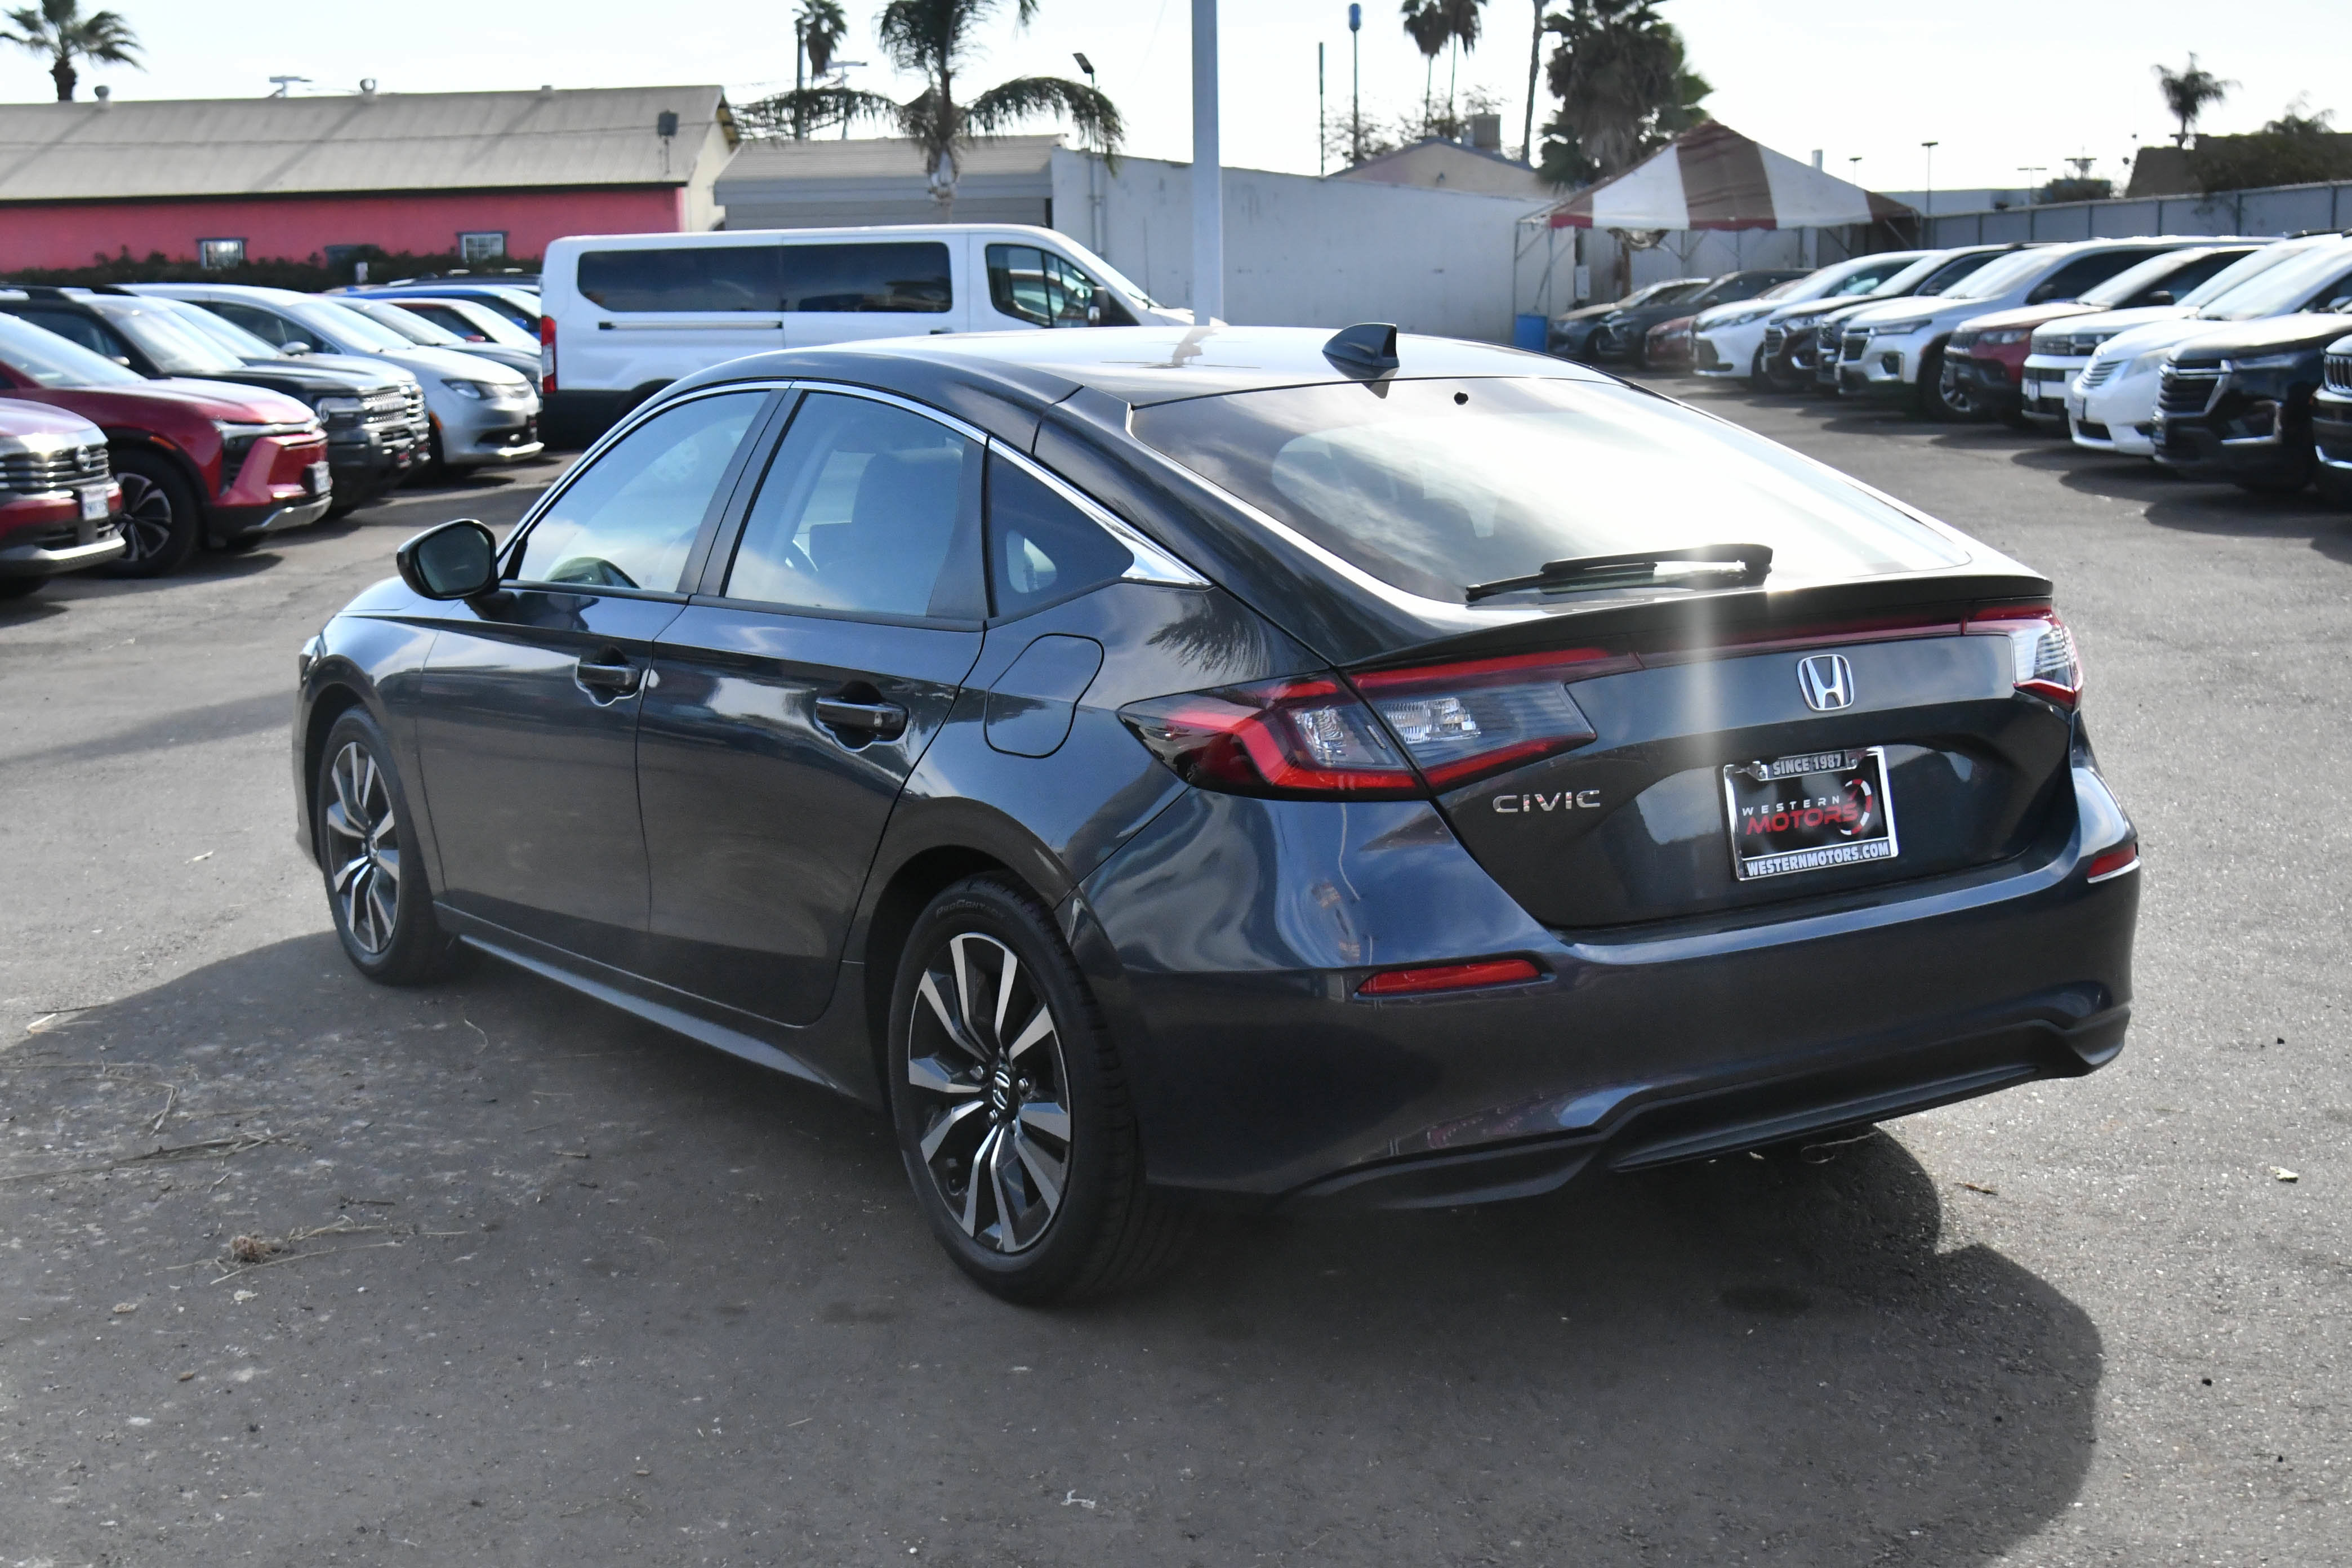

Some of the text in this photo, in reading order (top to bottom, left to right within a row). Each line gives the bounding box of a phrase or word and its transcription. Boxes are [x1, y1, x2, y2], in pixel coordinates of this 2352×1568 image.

[1772, 753, 1841, 775] SINCE 1987
[1493, 790, 1601, 813] CIVIC
[1743, 795, 1839, 816] WESTERN
[1746, 802, 1859, 835] MOTORS
[1747, 842, 1889, 877] WESTERNMOTORS.COM
